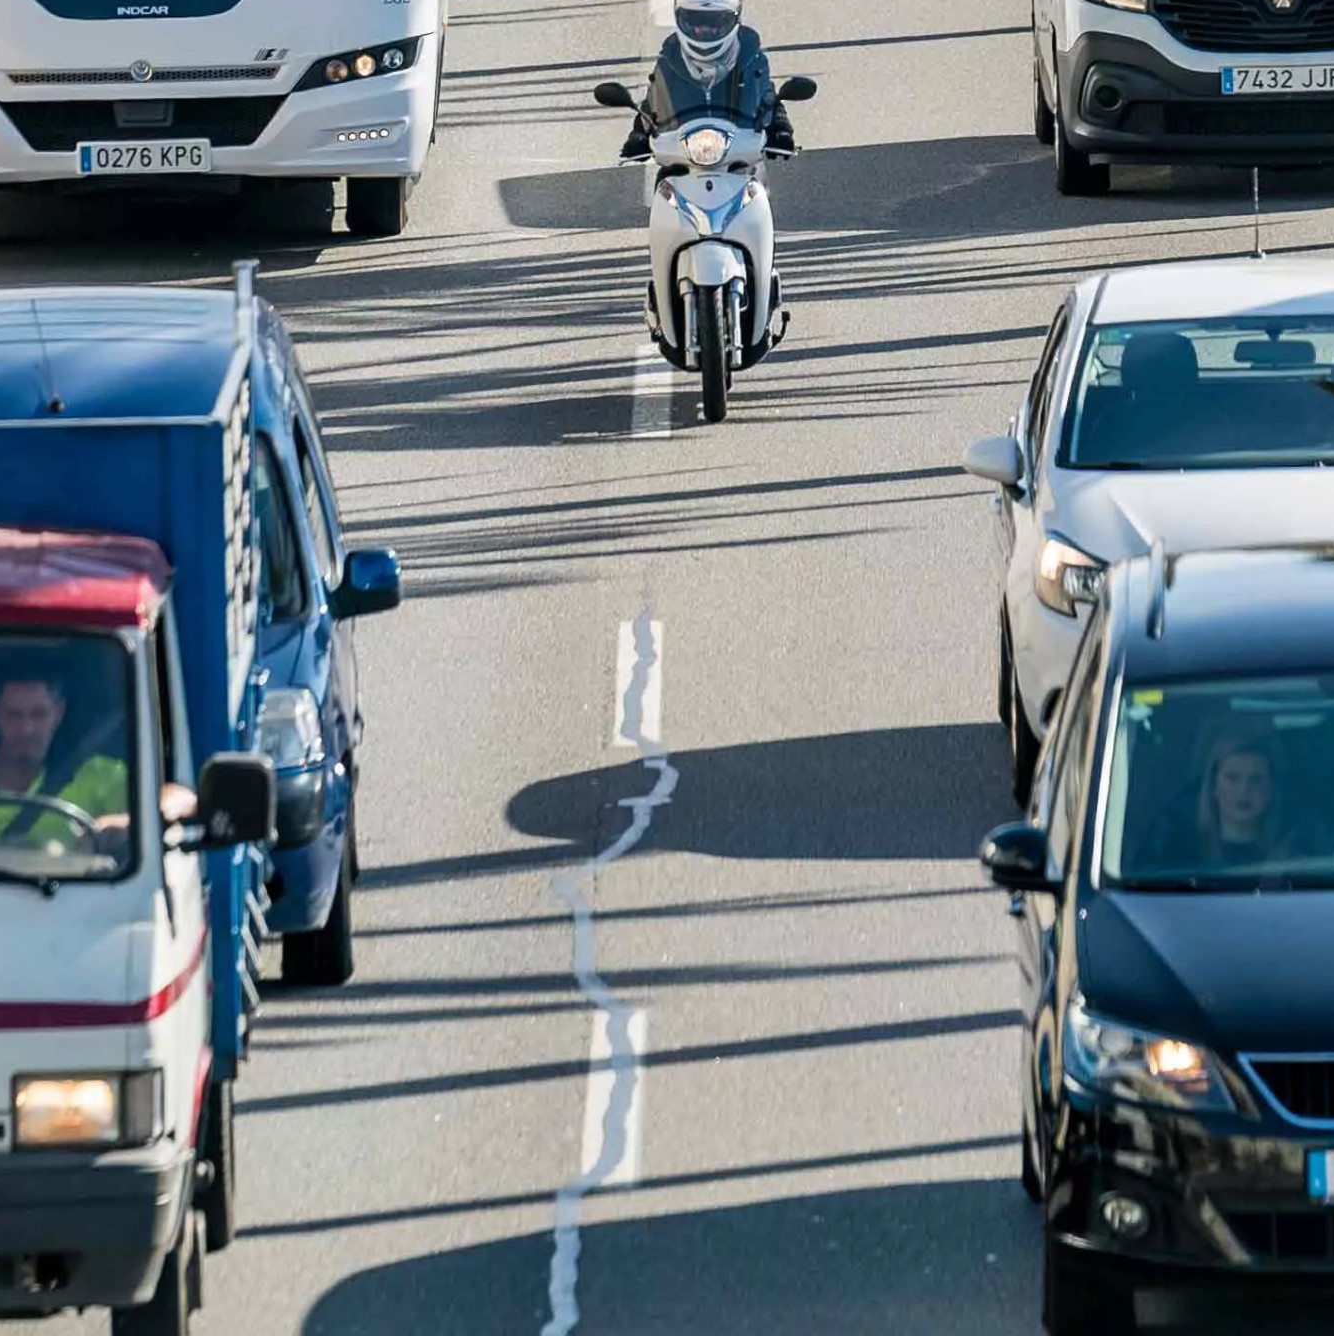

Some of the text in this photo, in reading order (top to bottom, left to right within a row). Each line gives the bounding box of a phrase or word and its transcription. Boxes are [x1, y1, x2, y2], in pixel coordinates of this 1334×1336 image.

[117, 5, 169, 15] INDCAR
[1237, 69, 1293, 89] 7432
[97, 146, 202, 168] 0276 KPG
